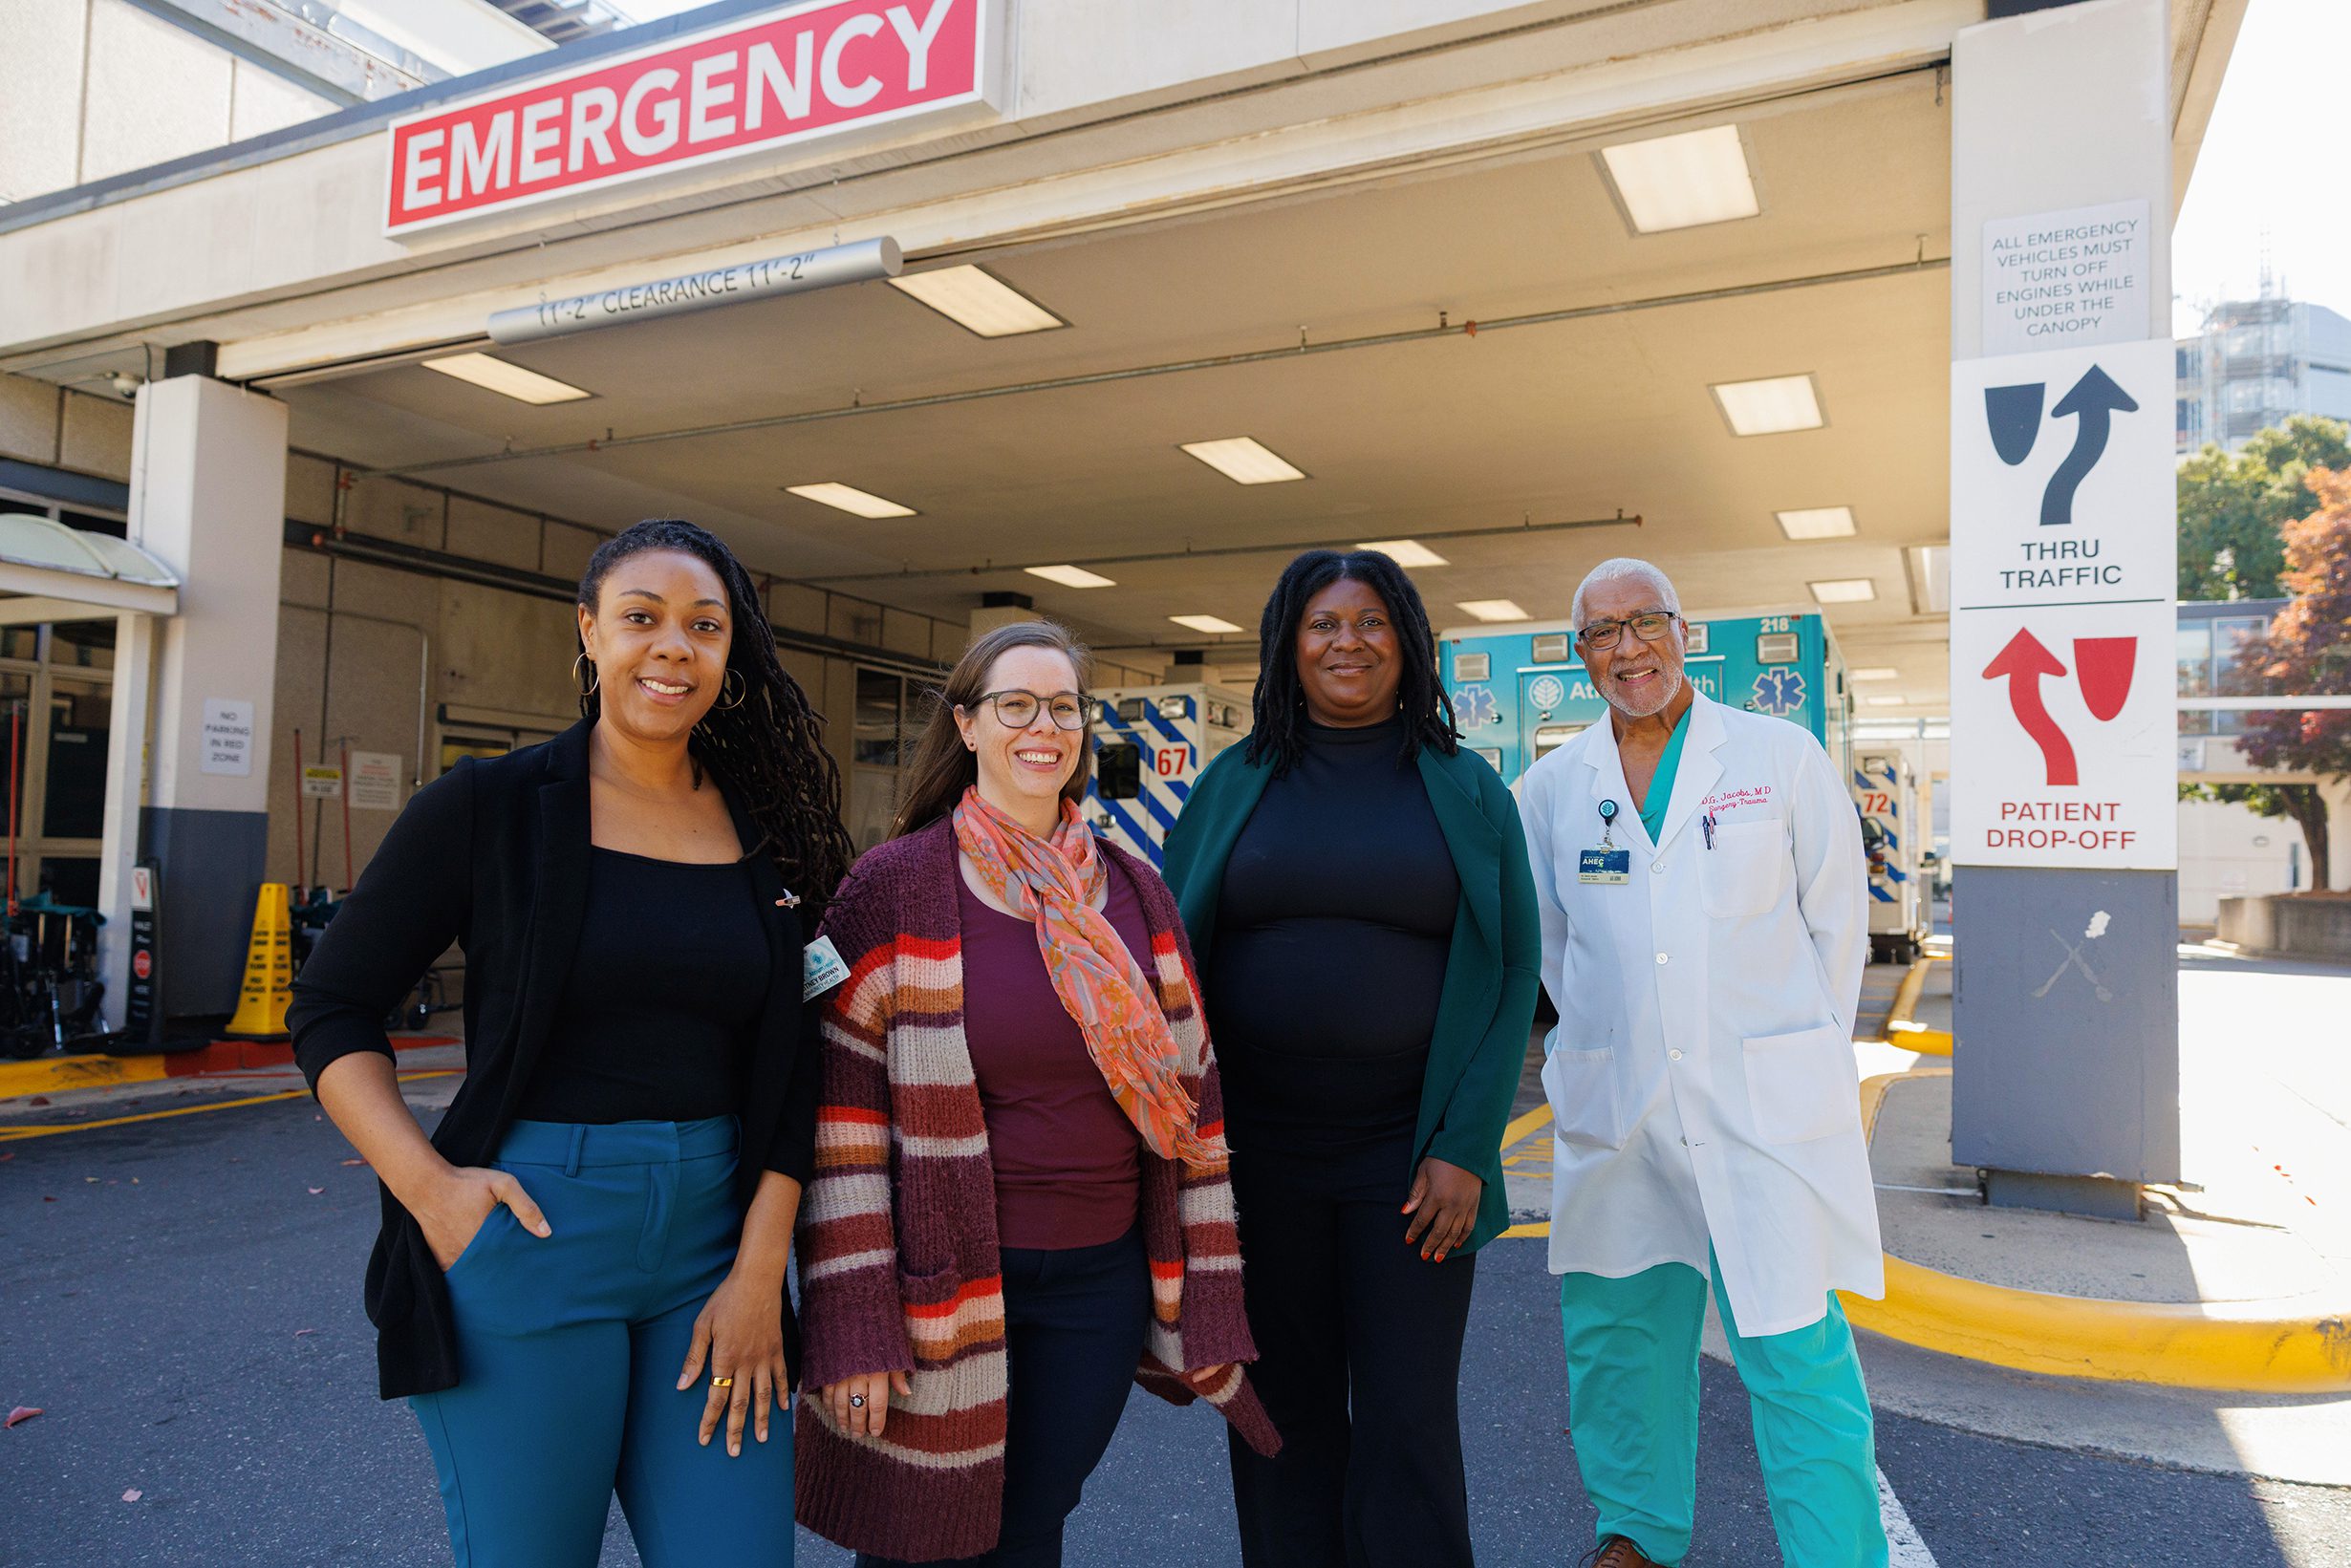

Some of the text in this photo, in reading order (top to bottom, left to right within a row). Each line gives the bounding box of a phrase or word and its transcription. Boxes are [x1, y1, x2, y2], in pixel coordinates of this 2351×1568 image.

[402, 0, 954, 212] EMERGENCY
[1992, 219, 2139, 251] ALL EMERGENCY
[1997, 239, 2133, 268] VEHICLES MUST
[2021, 260, 2108, 283] TURN OFF
[602, 268, 738, 315] CLEARANCE
[1996, 275, 2134, 305] ENGINES WHILE
[2015, 296, 2115, 320] UNDER THE
[2026, 316, 2102, 336] CANOPY
[2020, 539, 2100, 561] THRU
[1999, 565, 2123, 589] TRAFFIC
[1760, 617, 1789, 633] 218
[220, 712, 238, 721] NO
[1157, 748, 1186, 776] 67
[1864, 793, 1888, 813] 72
[2001, 803, 2121, 822] PATIENT
[1987, 828, 2136, 849] DROP-OFF
[818, 966, 840, 981] BROWN
